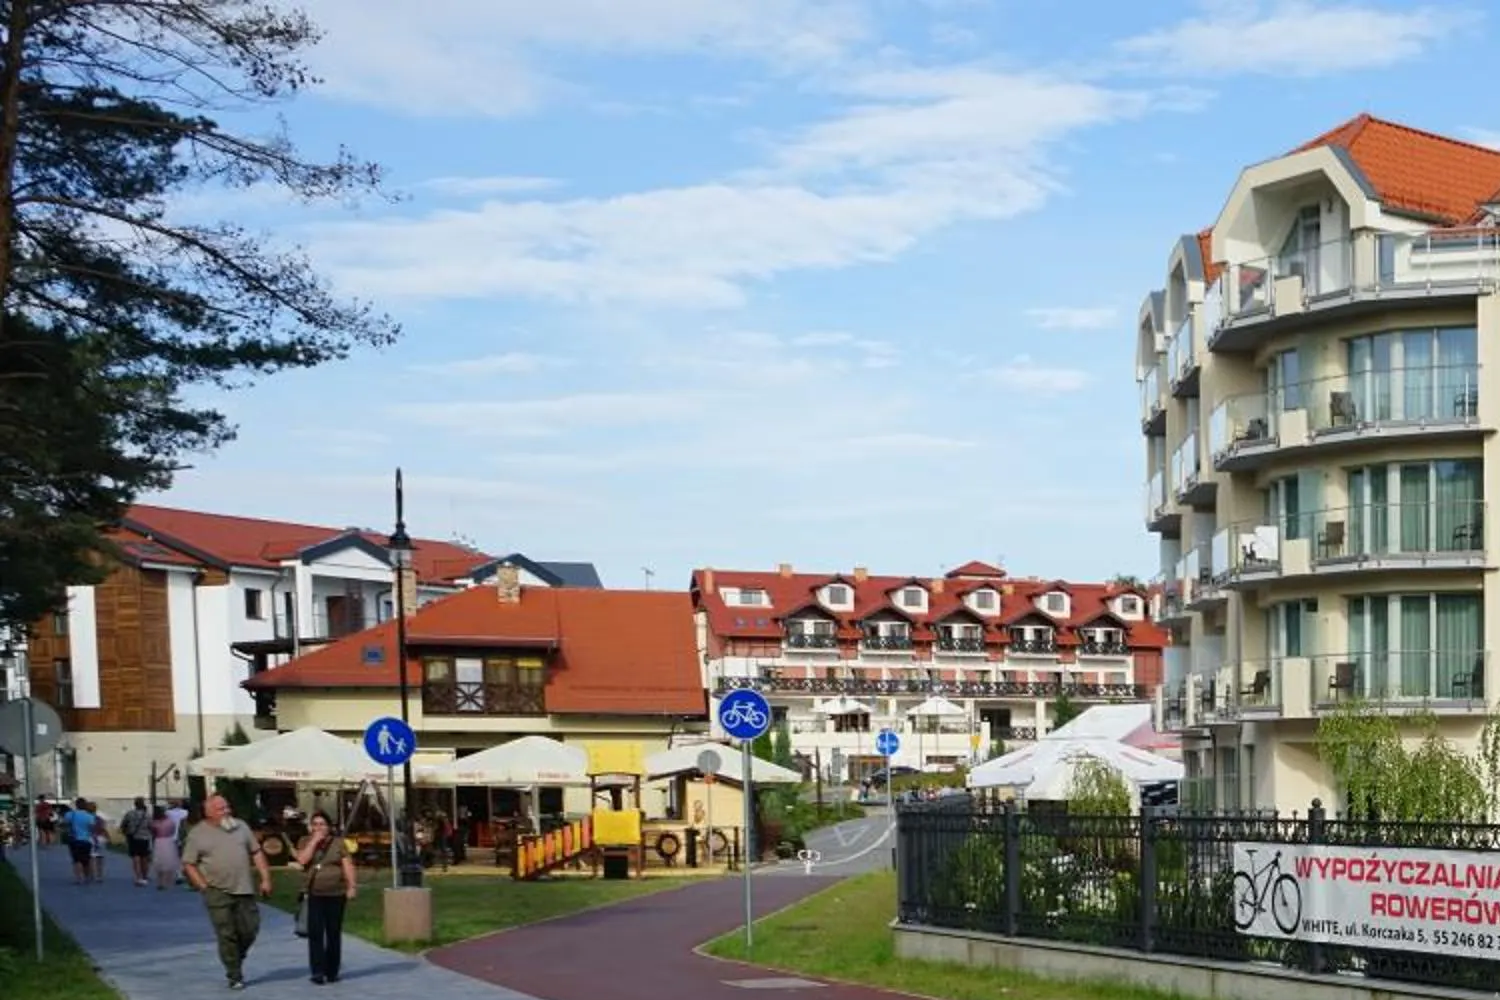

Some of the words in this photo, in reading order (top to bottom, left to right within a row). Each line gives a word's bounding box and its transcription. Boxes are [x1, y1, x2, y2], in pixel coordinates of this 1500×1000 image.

[1302, 920, 1343, 936] WHITE,
[1345, 921, 1360, 936] ul.
[1362, 923, 1414, 941] Korczaka
[1433, 930, 1448, 944] 55
[1451, 931, 1474, 947] 246
[1477, 933, 1493, 948] 82
